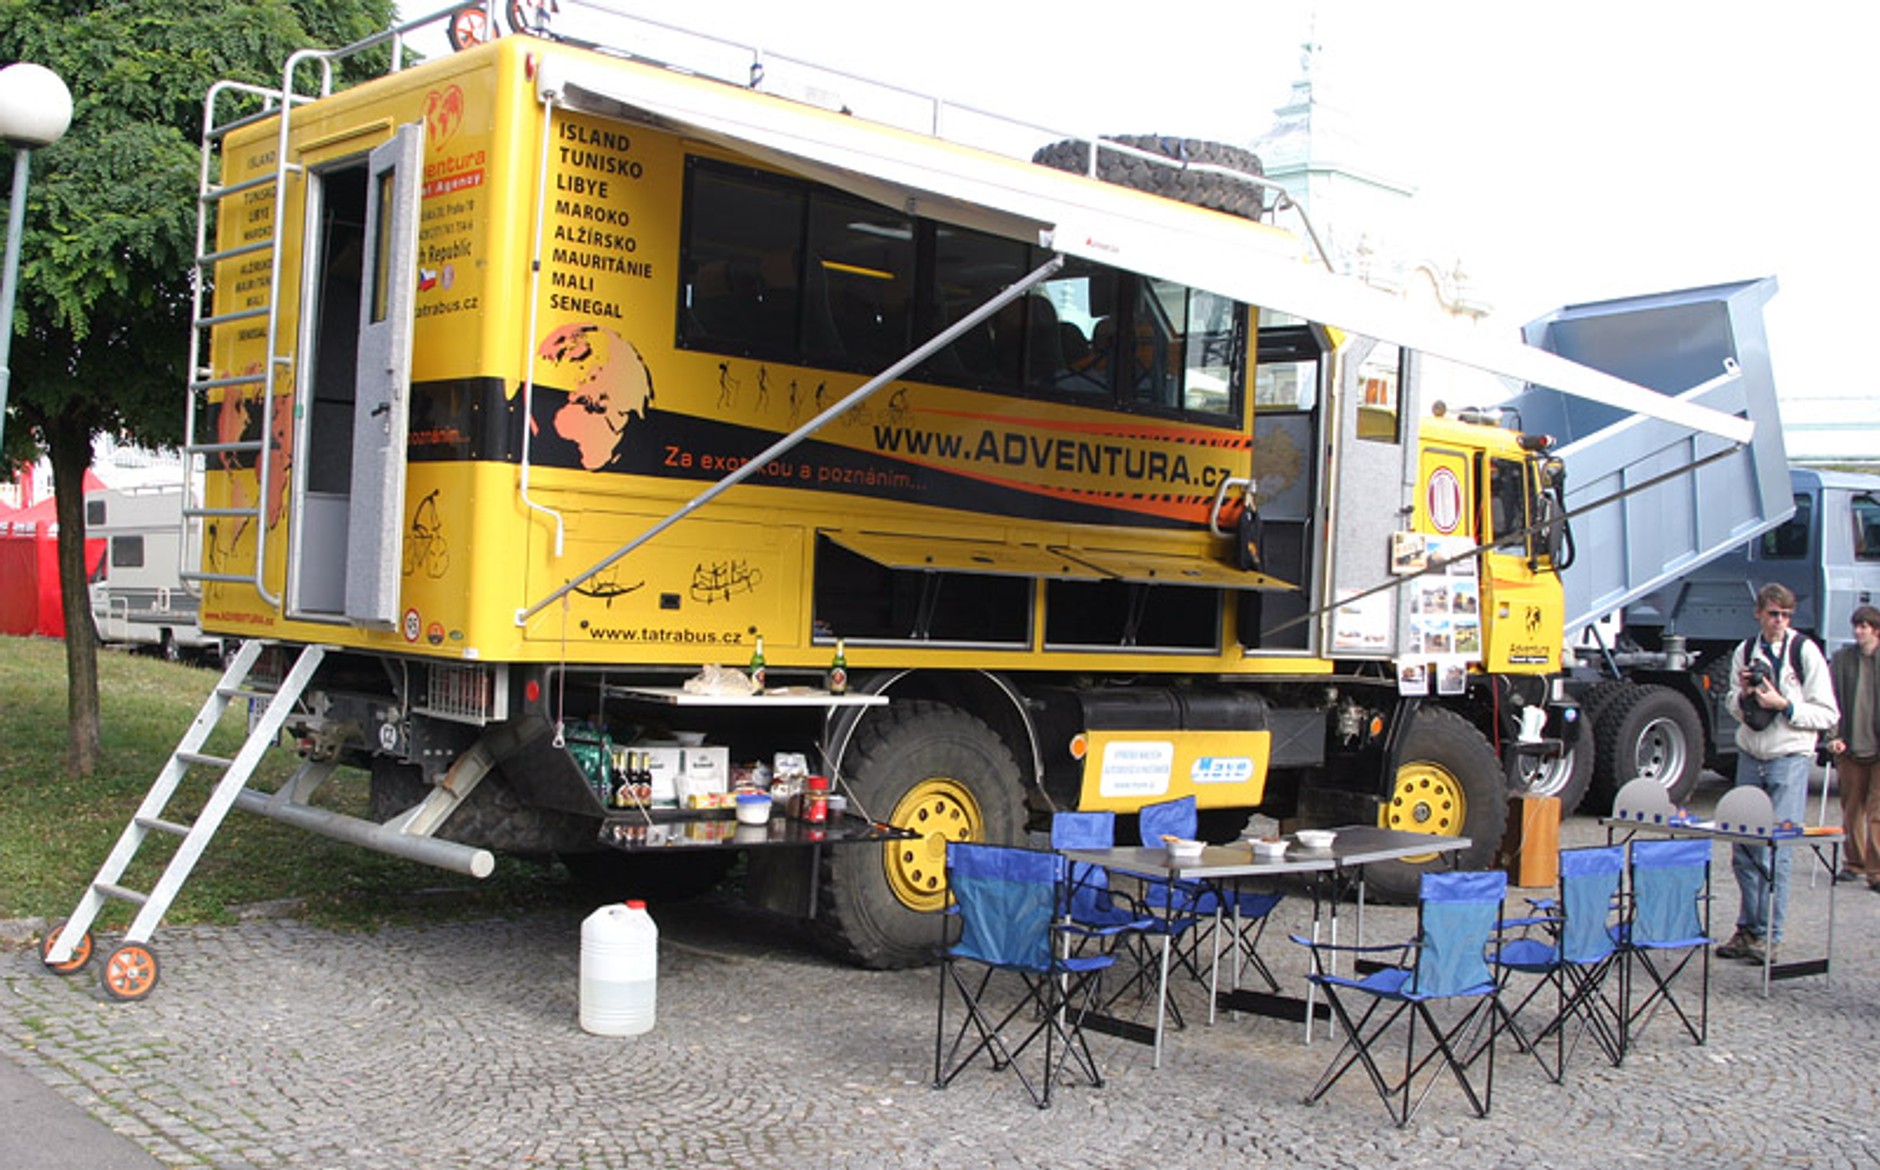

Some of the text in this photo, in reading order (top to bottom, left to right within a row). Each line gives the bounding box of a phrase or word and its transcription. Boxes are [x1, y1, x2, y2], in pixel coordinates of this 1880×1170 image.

[559, 122, 631, 152] ISLAND
[424, 150, 486, 178] entura
[559, 146, 644, 179] TUNISKO
[436, 173, 482, 194] Agency
[556, 173, 609, 199] LIBYE
[555, 200, 630, 227] MAROKO
[428, 239, 472, 266] Republic
[554, 225, 637, 253] ALŽÍRSKO
[552, 248, 653, 278] MAURITÁNIE
[551, 272, 594, 292] MALI
[550, 293, 623, 319] SENEGAL
[664, 445, 693, 468] Za
[799, 465, 811, 479] a
[873, 425, 1232, 488] www.ADVENTURA.cz
[589, 627, 743, 645] www.tatrabus.cz
